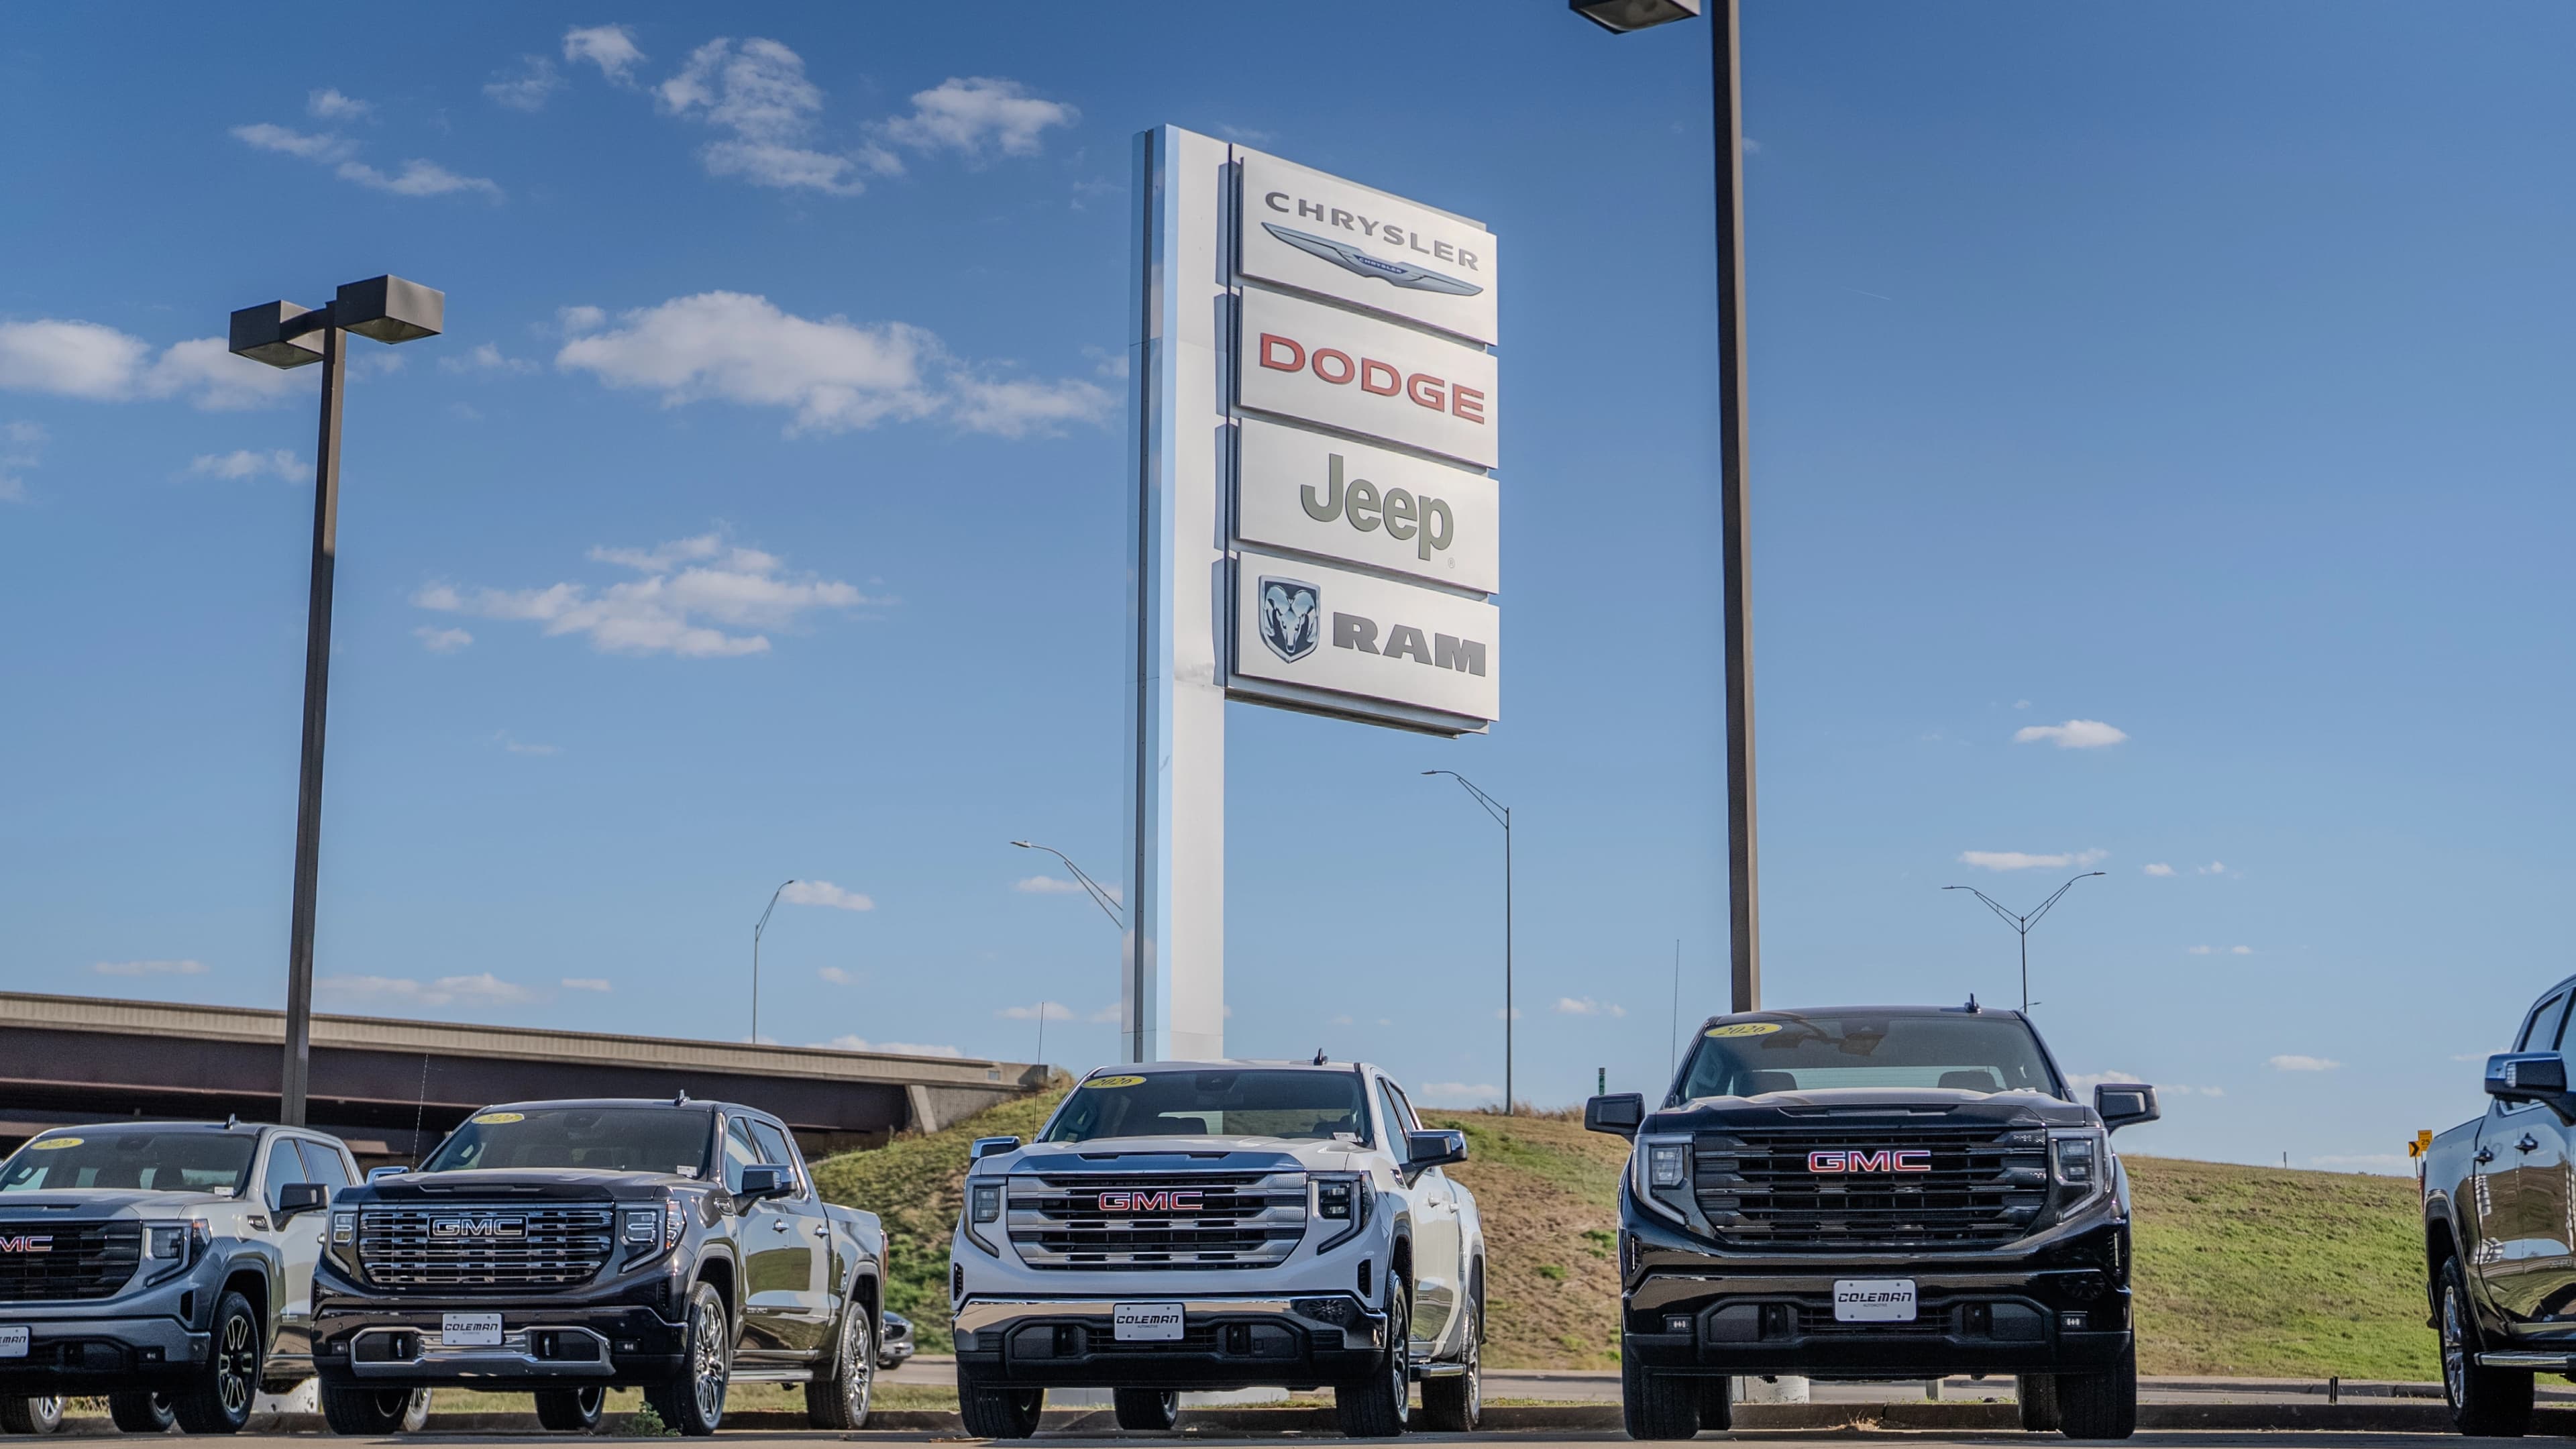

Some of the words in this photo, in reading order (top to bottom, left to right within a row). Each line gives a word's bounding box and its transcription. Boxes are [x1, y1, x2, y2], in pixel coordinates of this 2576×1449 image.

[1265, 191, 1479, 271] CHRYSLER
[1358, 257, 1403, 274] CHRYSLER
[1260, 332, 1485, 425] DODGE
[1300, 453, 1454, 561] Jeep
[1333, 611, 1486, 678] RAM
[1809, 1150, 1931, 1173] GMC
[1099, 1191, 1203, 1211] GMC
[433, 1218, 523, 1236] GMC
[1838, 1292, 1912, 1302] COLEMAN
[445, 1323, 498, 1331] COLEMAN
[1116, 1315, 1179, 1324] COLEMAN
[0, 1336, 27, 1344] MAN
